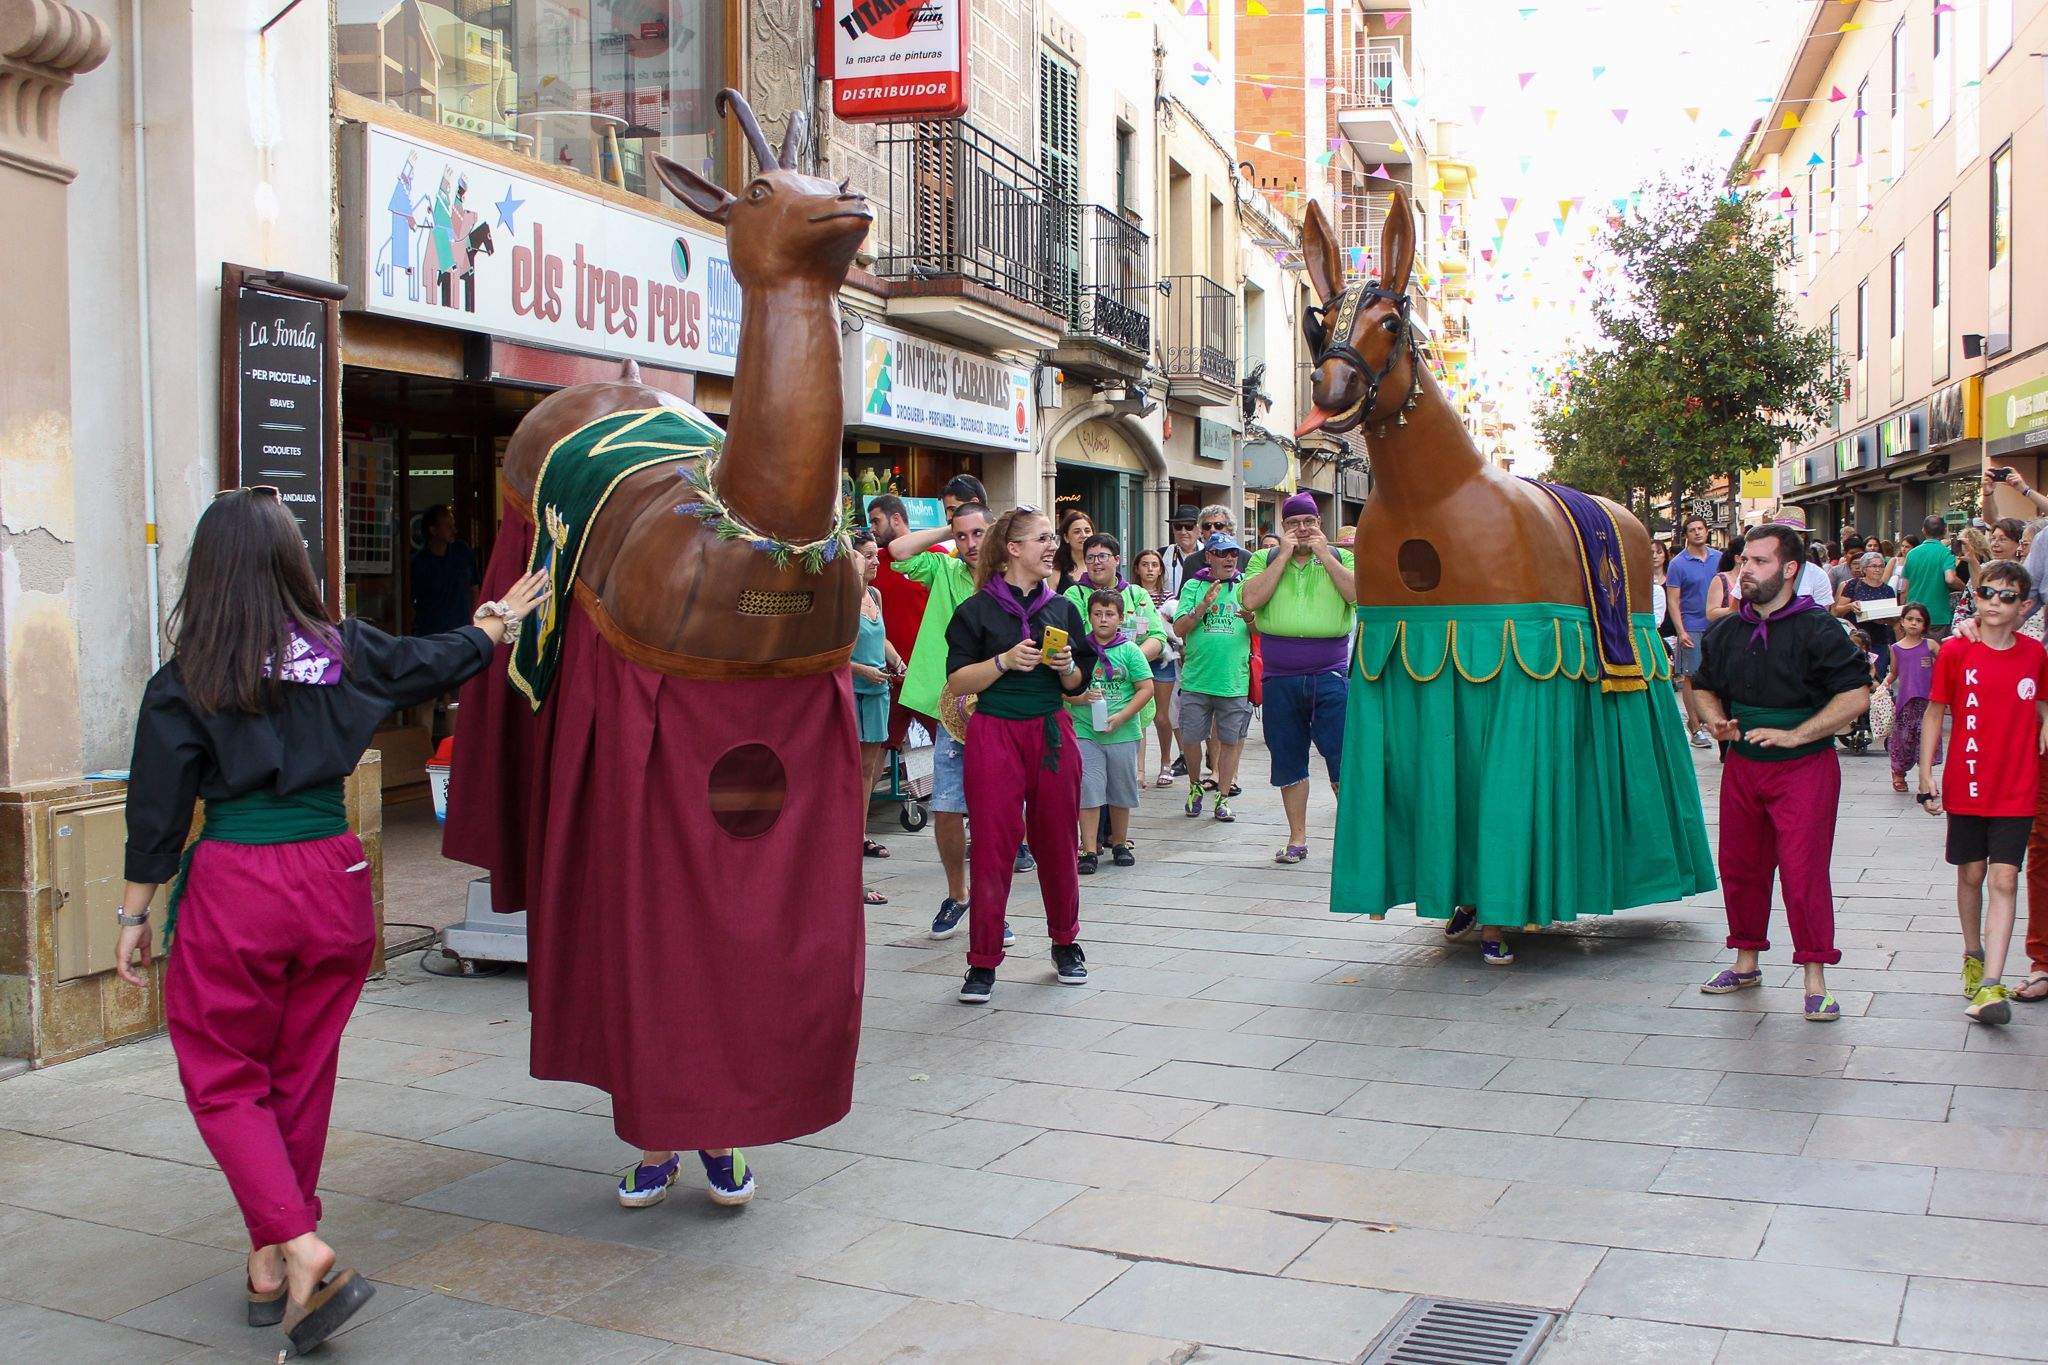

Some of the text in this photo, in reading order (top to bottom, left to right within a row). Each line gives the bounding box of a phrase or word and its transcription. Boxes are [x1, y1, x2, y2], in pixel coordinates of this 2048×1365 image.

[845, 50, 943, 65] la marca de pinturas
[842, 83, 947, 101] DISTRIBUIDOR
[511, 221, 701, 351] els tres reis
[249, 318, 317, 350] La Fonda
[252, 368, 312, 386] PER PICOTEJAR
[896, 340, 1010, 411] PINTURES CABANAS
[269, 398, 295, 409] BRAVES
[262, 445, 302, 456] CROQUETES
[282, 493, 317, 503] ANDALUSA
[1965, 668, 1979, 798] KARATE
